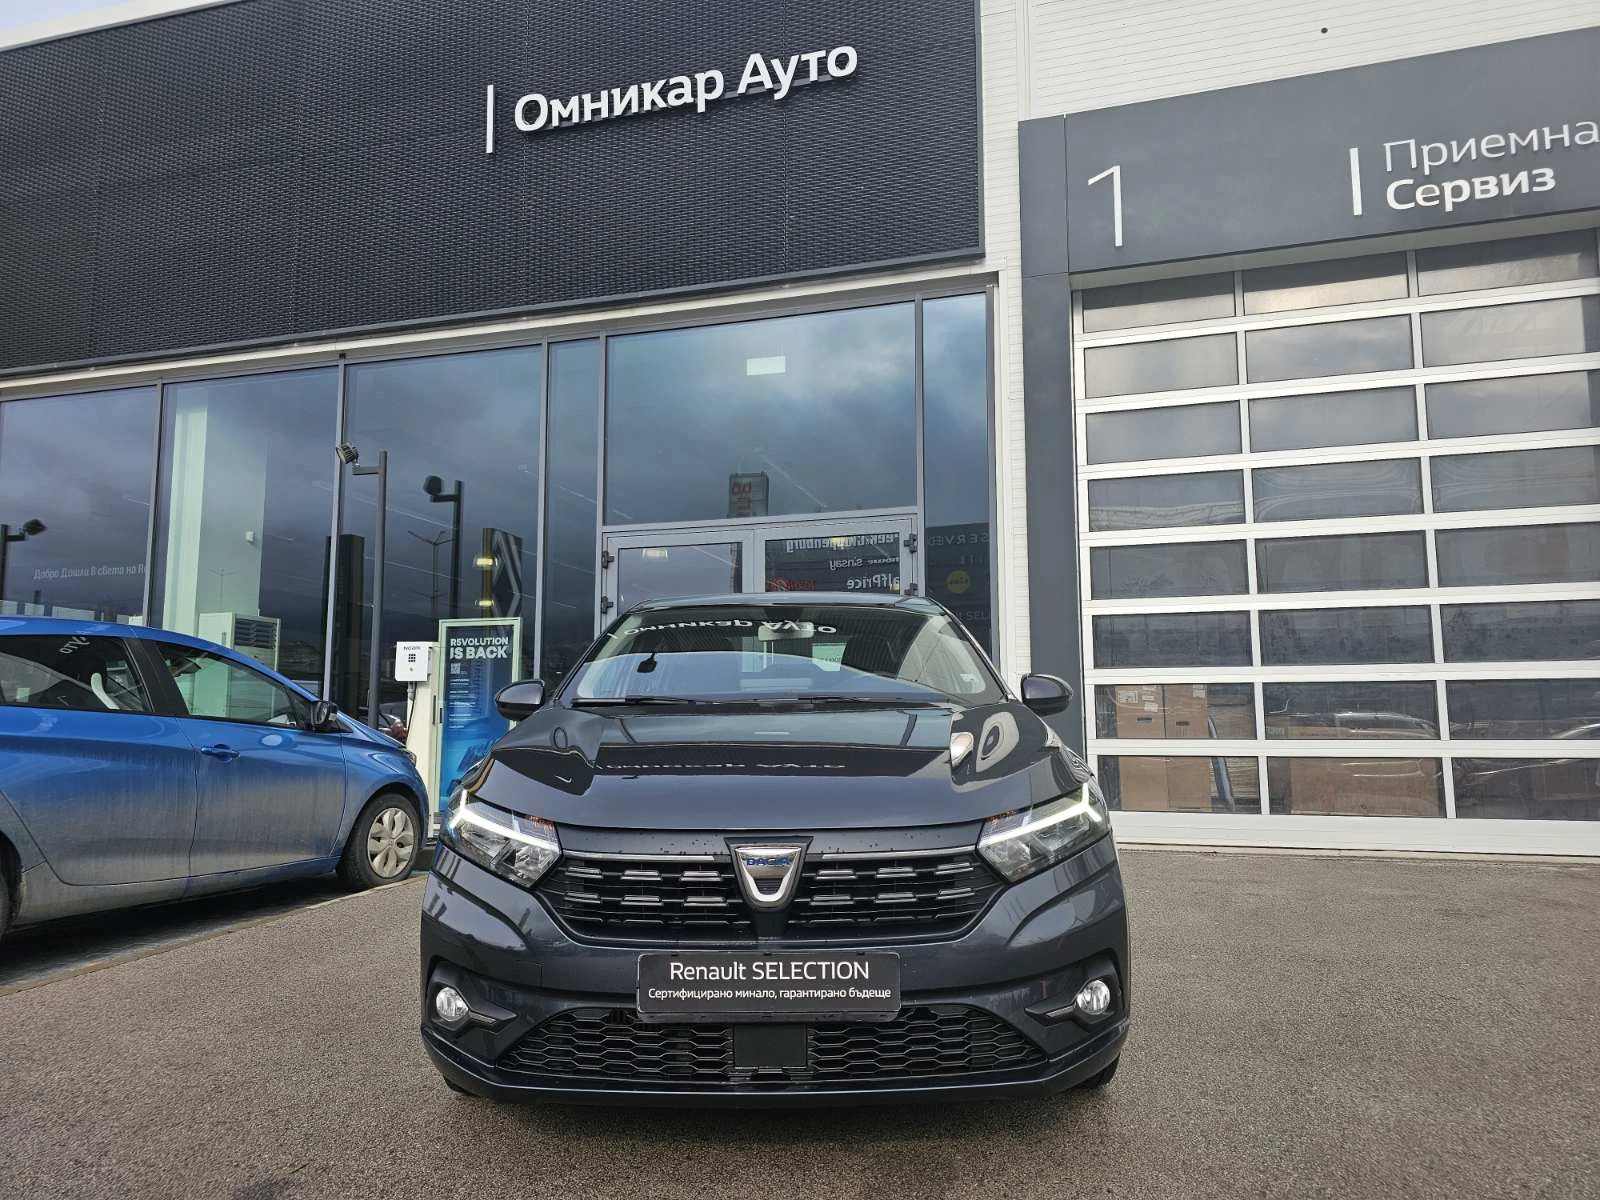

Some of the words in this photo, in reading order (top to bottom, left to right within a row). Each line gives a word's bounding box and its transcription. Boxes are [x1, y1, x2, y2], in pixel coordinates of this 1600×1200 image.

[514, 68, 724, 132] Омникар
[737, 45, 858, 100] Ауто
[1383, 120, 1600, 176] Приемна
[1088, 164, 1123, 248] 1
[1386, 166, 1556, 212] Сервиз
[450, 646, 464, 659] IS
[466, 645, 508, 659] BACK
[648, 987, 733, 1001] Сертифицирано
[735, 988, 777, 999] минало,
[779, 988, 847, 999] гарантирано
[848, 986, 892, 999] бъдеще
[669, 961, 747, 981] Renault
[752, 961, 870, 981] SELECTION
